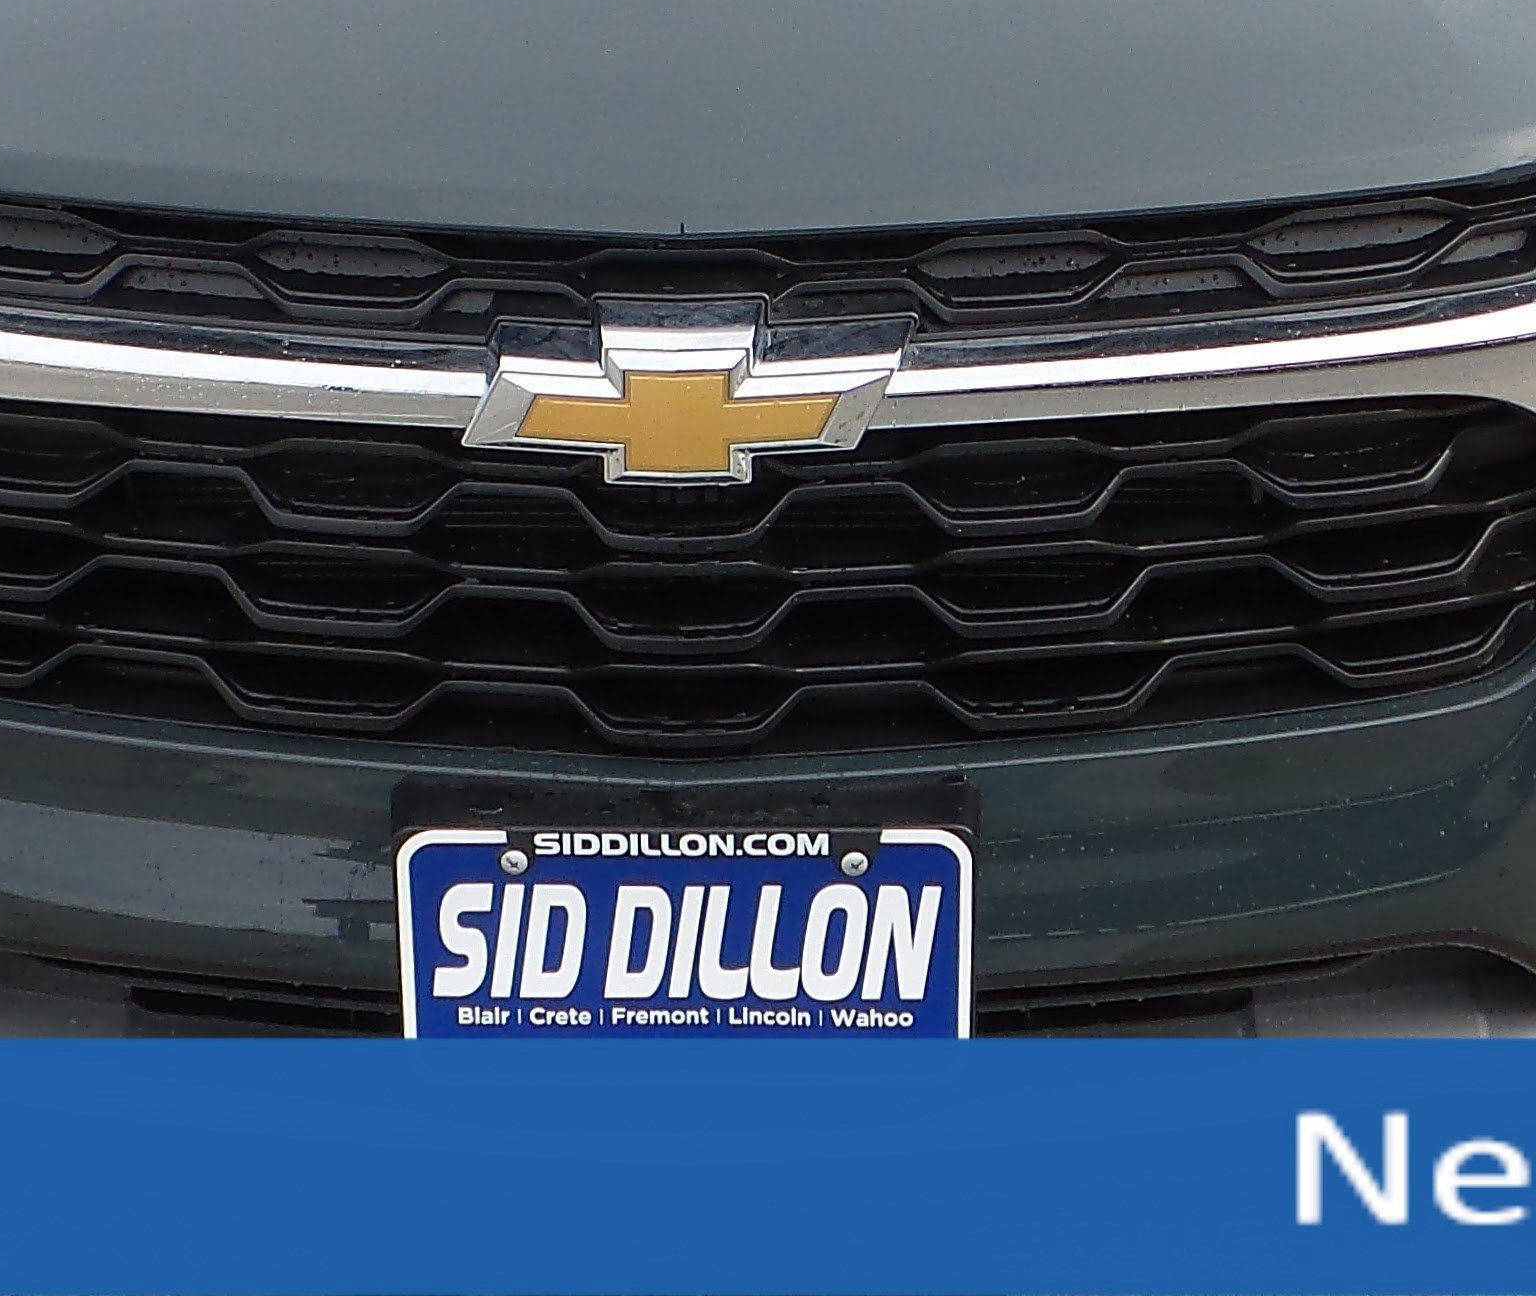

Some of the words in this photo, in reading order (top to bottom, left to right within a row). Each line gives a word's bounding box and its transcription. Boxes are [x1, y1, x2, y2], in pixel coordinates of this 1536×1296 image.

[534, 833, 830, 858] SIDDILLON.COM
[433, 883, 587, 999] SID
[604, 884, 942, 1001] DILLON
[458, 1006, 510, 1027] Blair
[530, 1007, 591, 1027] Crete
[612, 1007, 710, 1027] Fremont
[729, 1007, 810, 1027] Lincoln
[831, 1008, 914, 1028] Wahoo
